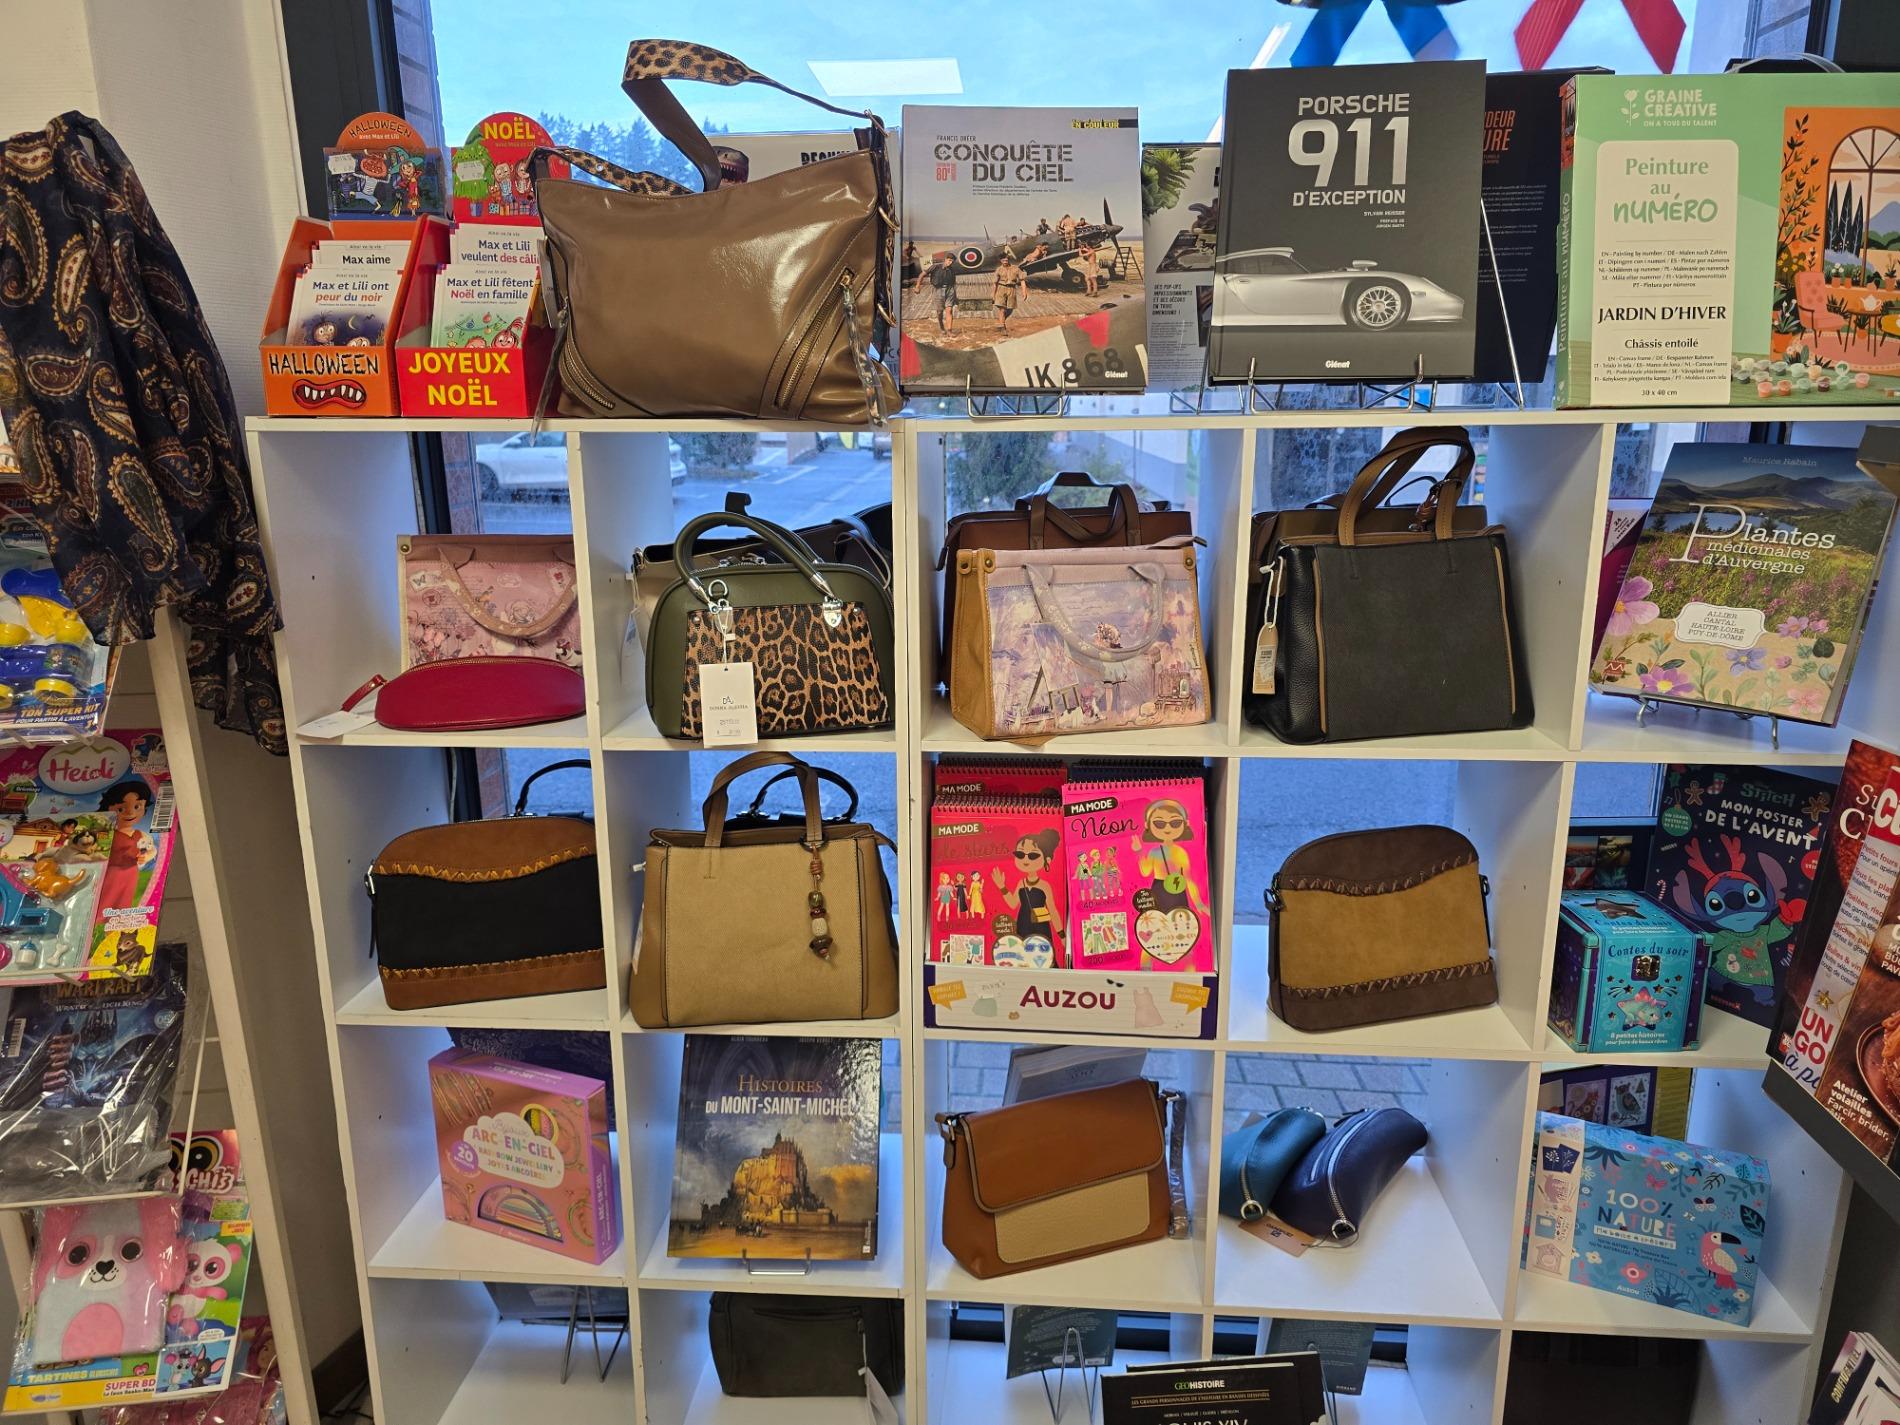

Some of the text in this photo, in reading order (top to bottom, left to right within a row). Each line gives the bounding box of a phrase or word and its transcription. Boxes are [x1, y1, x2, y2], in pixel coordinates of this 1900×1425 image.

[1298, 92, 1410, 116] PORSCHE
[1644, 89, 1703, 103] GRAINE
[347, 119, 413, 139] HALLOWEEN
[484, 116, 536, 140] NOËL
[1071, 119, 1120, 129] EN COULEUR
[1693, 119, 1717, 127] TALENT
[934, 139, 1073, 162] CONQUÊTE
[1287, 116, 1410, 188] 911
[972, 163, 1074, 183] DU CIEL
[1625, 157, 1710, 176] Peinture
[1292, 189, 1406, 207] D'EXCEPTION
[1650, 183, 1672, 195] au
[478, 240, 531, 252] Max et Lili
[342, 254, 391, 265] Max aime
[461, 251, 518, 263] veulent des
[1561, 259, 1568, 279] au
[312, 281, 390, 291] Max et Lili ont
[447, 277, 534, 288] Max et Lili fêtent
[315, 292, 383, 303] peur du noir
[450, 288, 529, 300] Noël en famille
[1558, 283, 1568, 353] Peinture
[1597, 305, 1727, 325] JARDIN D'HIVER
[1624, 338, 1700, 349] Châssis entoilé
[269, 352, 379, 377] HALLOWEEN
[408, 352, 512, 376] JOYEUX
[1325, 360, 1350, 370] Glénat
[1104, 370, 1129, 378] Glénat
[428, 379, 499, 406] NOËL
[1742, 456, 1782, 465] Maurice
[1668, 502, 1837, 564] Plantes
[1705, 541, 1812, 561] médicinales
[1701, 553, 1806, 575] d'Auvergne
[1703, 617, 1738, 627] CANTAL
[1706, 610, 1739, 620] ALLIER
[20, 702, 102, 719] TON SUPER KIT
[34, 716, 58, 724] PARTIR
[46, 756, 115, 783] Heidi
[942, 783, 983, 795] MA MODE
[1071, 798, 1114, 815] MA MODE
[1720, 799, 1804, 829] MON POSTER
[938, 823, 980, 836] MA MODE
[1071, 816, 1139, 840] Néon
[1705, 808, 1728, 828] DE
[1732, 815, 1818, 850] L'AVENT
[1859, 850, 1880, 866] Pour un
[1879, 850, 1899, 869] fours
[1854, 867, 1876, 886] Tous les
[1608, 941, 1690, 958] Contes du soir
[1801, 1006, 1835, 1045] UN
[1615, 1030, 1666, 1040] petites histoires
[1785, 1051, 1799, 1072] à
[1832, 1079, 1869, 1105] Atelier
[705, 1100, 719, 1114] DU
[1830, 1088, 1874, 1120] volailles
[1827, 1096, 1890, 1142] Farcir, brider,
[472, 1126, 556, 1161] ARC EN-CIEL
[456, 1146, 474, 1163] 20
[1605, 1188, 1675, 1219] 100%
[1597, 1205, 1677, 1239] NATURE
[27, 1369, 89, 1384] TARTINES
[1830, 1348, 1863, 1404] CONFIDENTIEL
[104, 1378, 157, 1393] SUPER BD
[1139, 1397, 1159, 1405] GRANDS
[1158, 1396, 1191, 1404] PERSONNAGES
